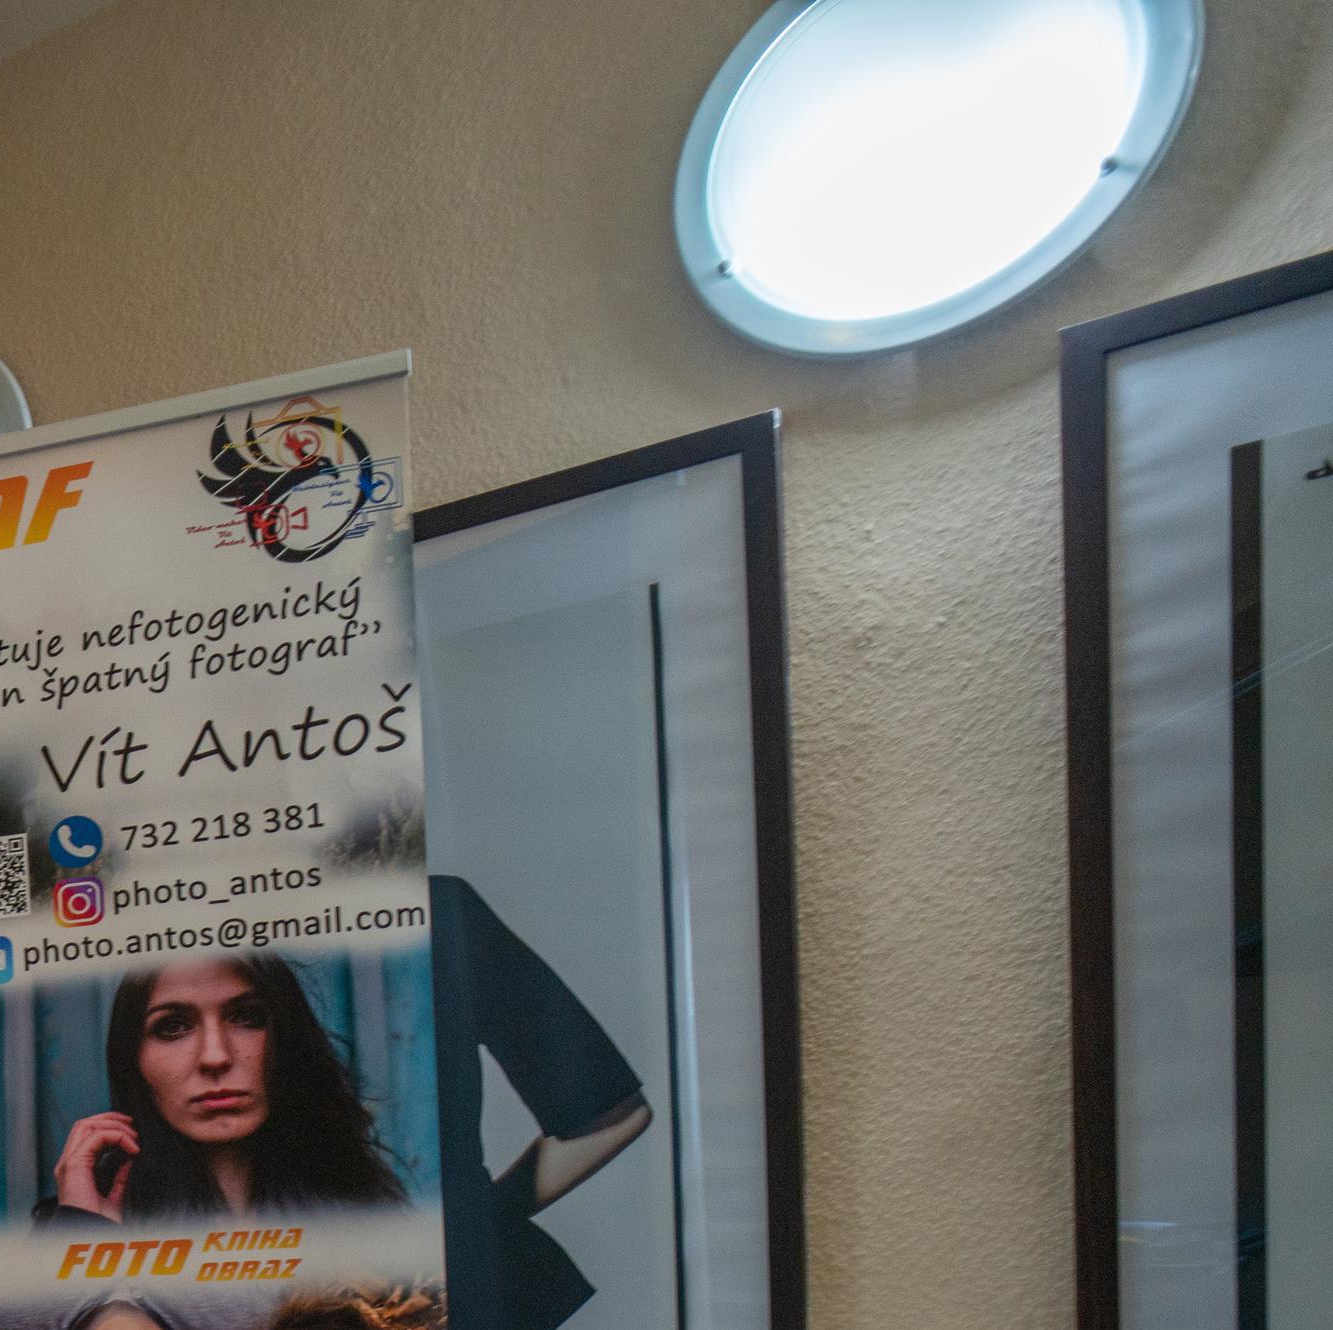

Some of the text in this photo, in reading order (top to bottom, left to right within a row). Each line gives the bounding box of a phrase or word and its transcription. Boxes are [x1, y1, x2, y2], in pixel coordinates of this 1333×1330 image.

[80, 575, 363, 653] nefotogenický
[40, 652, 172, 710] špatný
[41, 681, 414, 794] Vít Antoš
[120, 802, 325, 852] 732 218 381
[113, 866, 323, 915] photo_antos
[23, 903, 427, 972] photo.antos@gmail.com
[56, 1228, 304, 1281] FOTO KNIHA
[196, 1258, 303, 1283] OBRAZ
